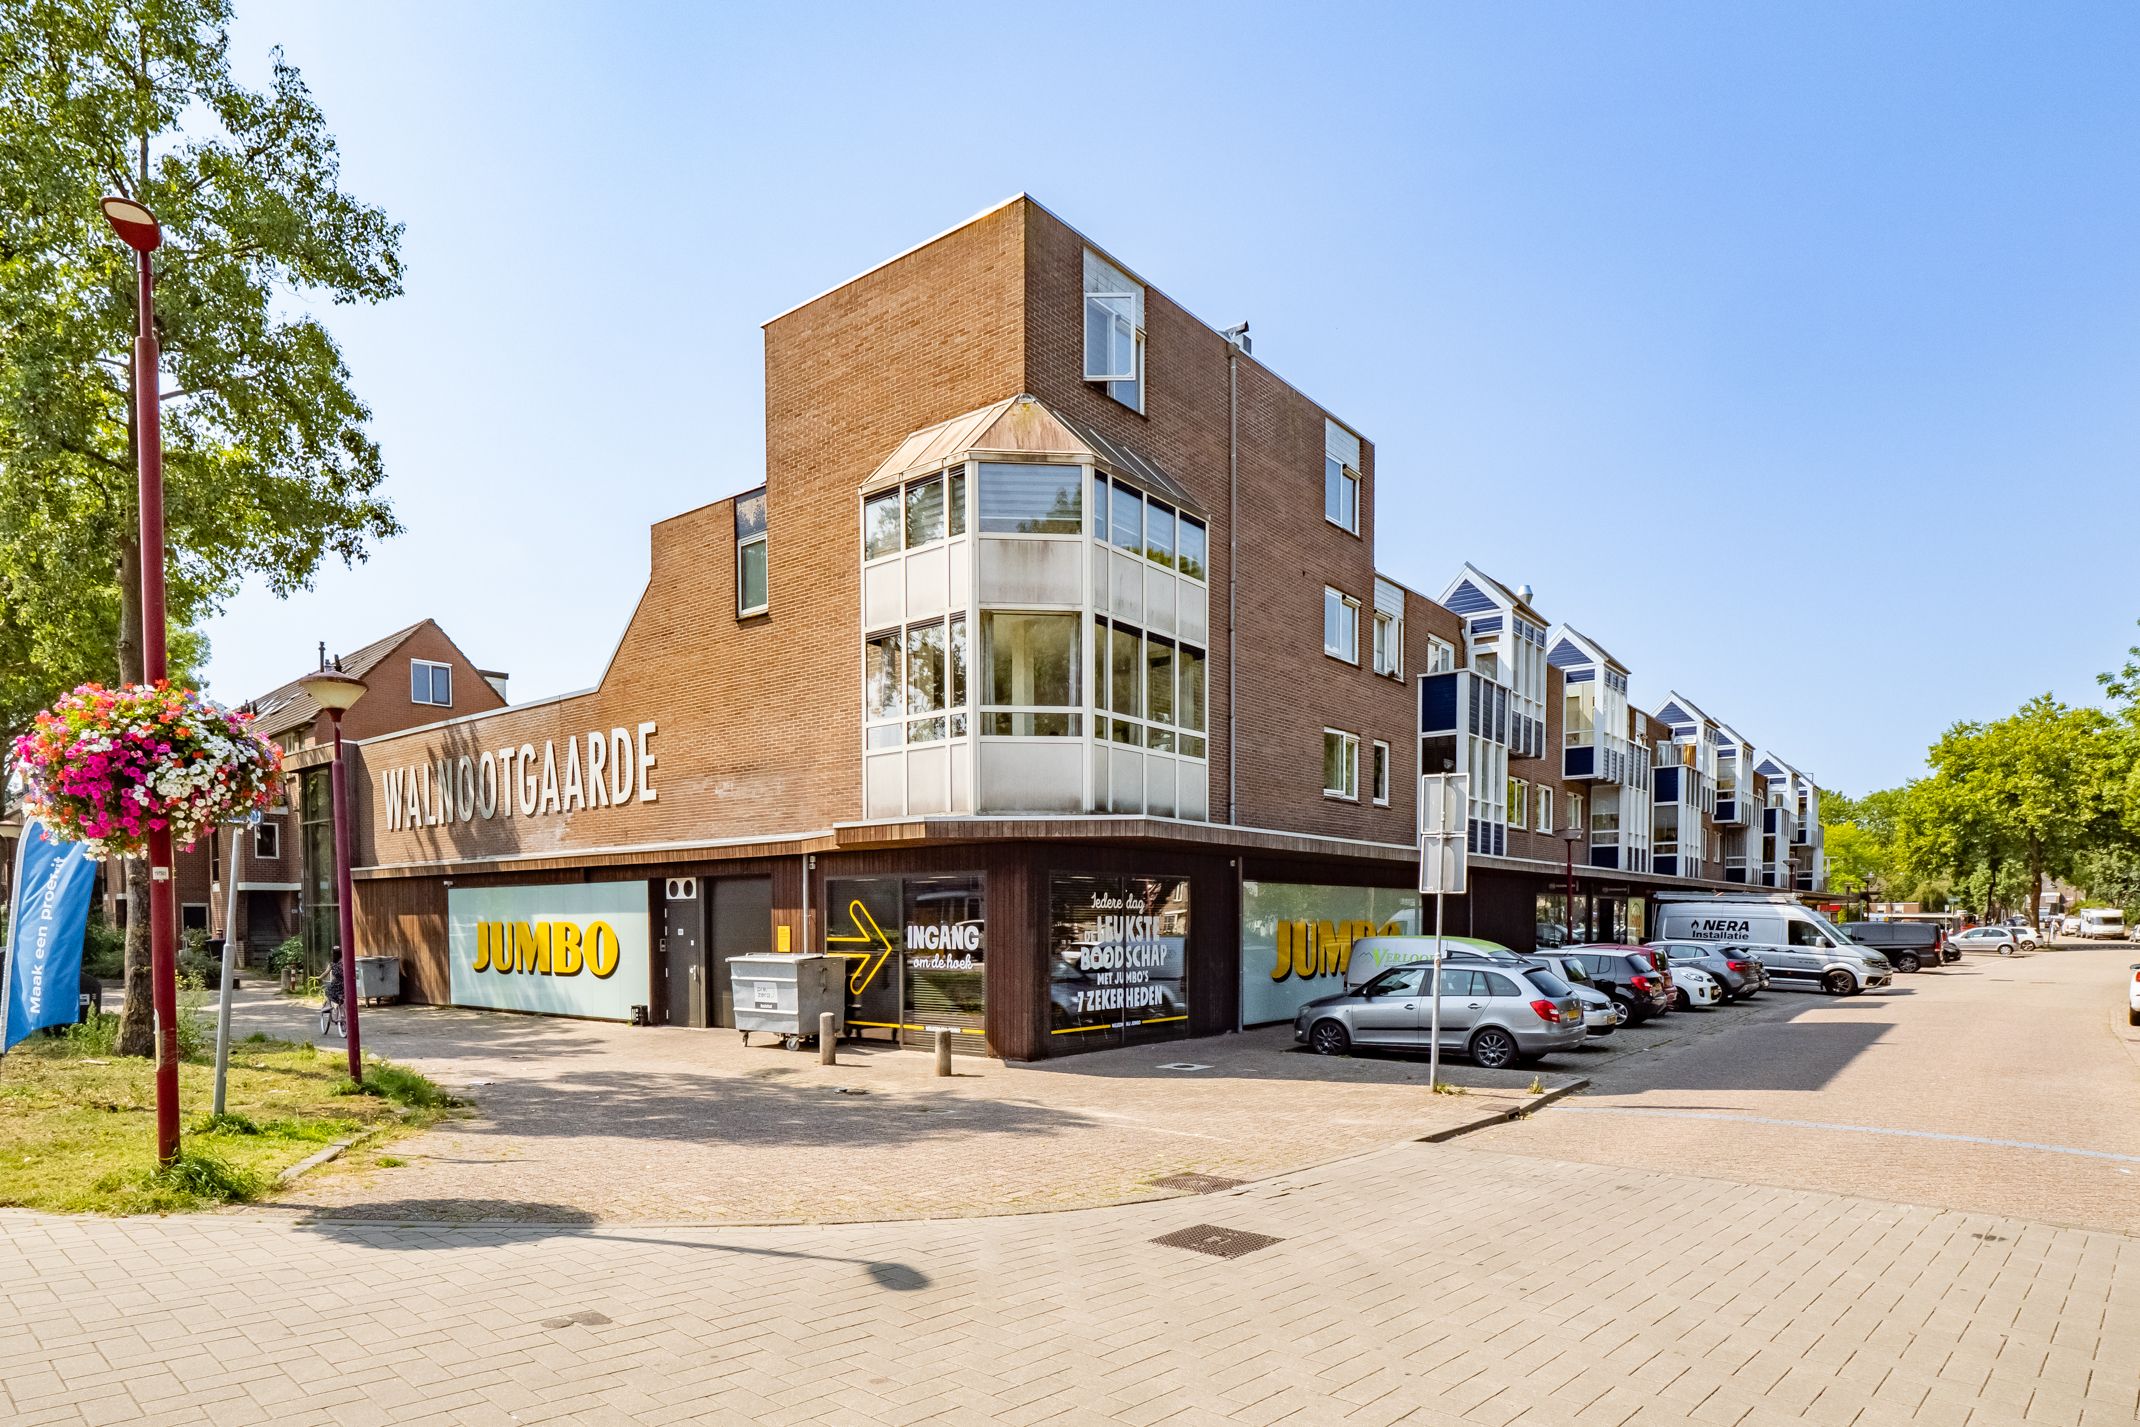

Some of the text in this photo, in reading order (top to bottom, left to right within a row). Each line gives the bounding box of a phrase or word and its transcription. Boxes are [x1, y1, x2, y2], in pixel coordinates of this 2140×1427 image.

[383, 721, 657, 830] WALNOOTGAARDE
[1125, 893, 1145, 914] dag
[907, 925, 980, 951] INGANG
[1097, 915, 1160, 942] LEUKSTE
[1692, 930, 1749, 940] Installatie
[1703, 920, 1749, 932] NERA
[35, 925, 48, 960] een
[472, 920, 620, 979] JUMBO
[913, 953, 973, 970] om de hoek
[1080, 944, 1168, 970] BOODSCHAP
[30, 963, 43, 1014] Maak
[1097, 970, 1149, 986] MET JUMBO'S
[1077, 985, 1163, 1012] 7 ZEKERHEDEN
